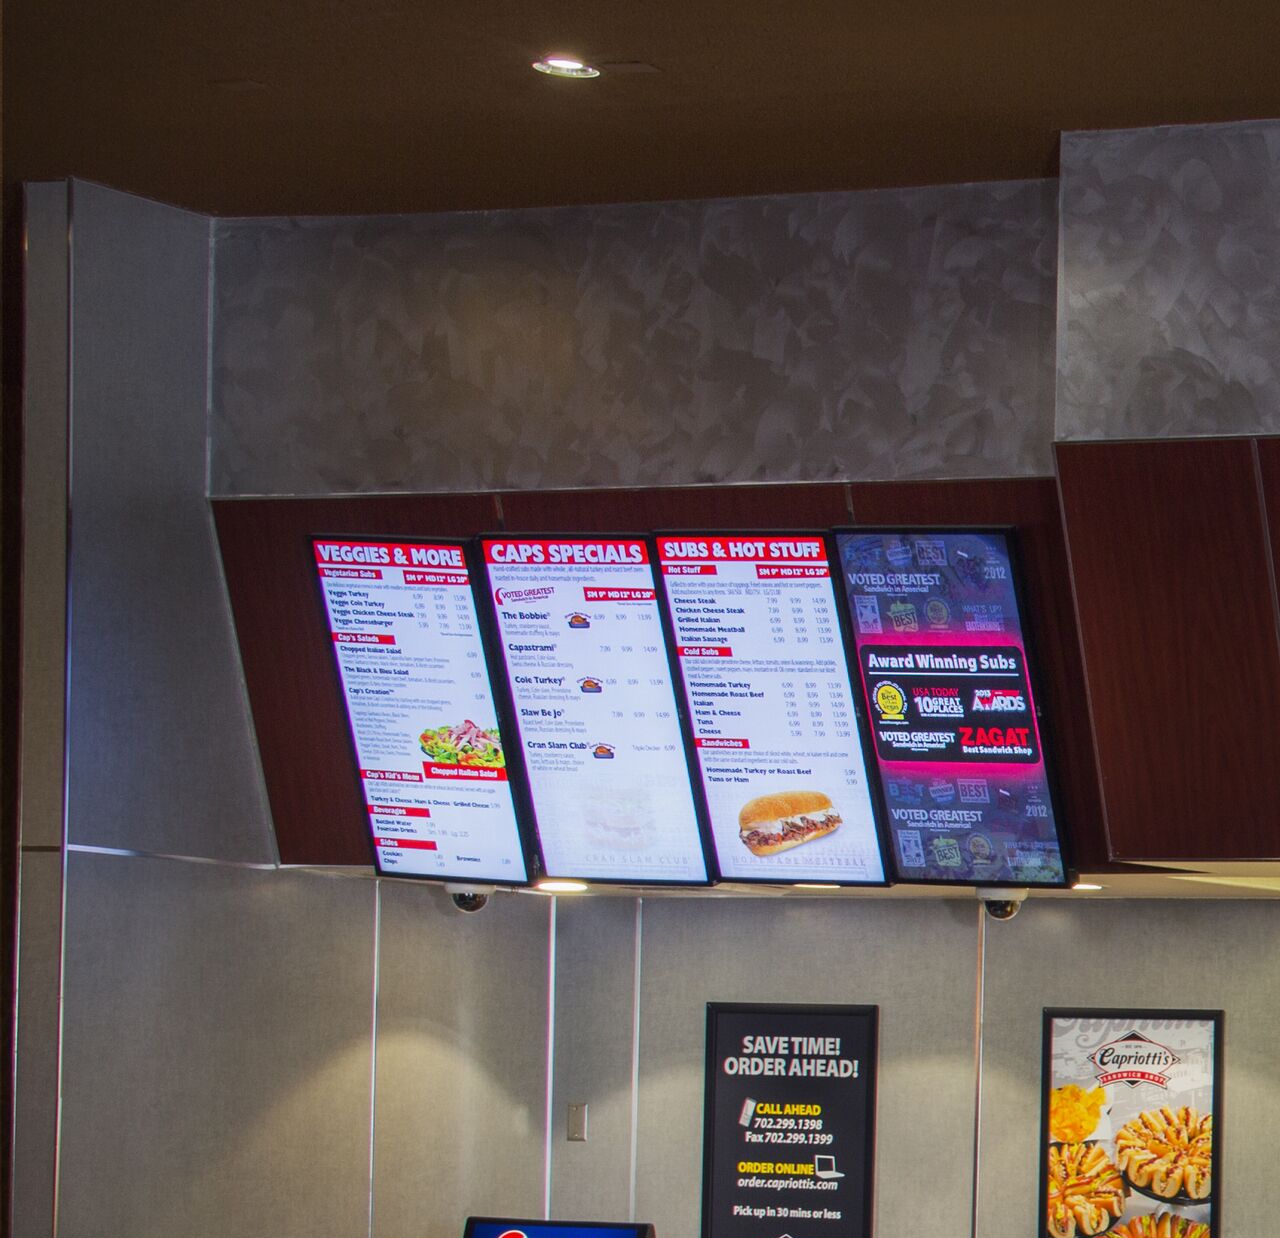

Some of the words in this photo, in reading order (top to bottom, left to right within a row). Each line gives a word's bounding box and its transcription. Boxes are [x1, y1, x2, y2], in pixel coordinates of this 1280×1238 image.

[490, 544, 545, 564] CAPS
[548, 544, 643, 564] SPECIALS
[663, 541, 709, 559] SUBS
[712, 542, 727, 558] &
[728, 542, 766, 558] HOT
[769, 541, 821, 559] STUFF
[316, 544, 391, 565] VEGGIES
[394, 548, 409, 566] &
[411, 548, 464, 567] MORE
[360, 570, 377, 579] Subs
[667, 566, 682, 575] Hot
[682, 566, 701, 575] Stuff
[848, 573, 886, 586] VOTED
[886, 573, 941, 586] GREATEST
[348, 590, 370, 600] Turkey
[501, 589, 524, 600] VOTED
[524, 586, 555, 597] GREATEST
[364, 601, 385, 610] Turkey
[697, 597, 717, 605] Steak
[352, 609, 376, 617] Chicken
[501, 611, 518, 620] The
[702, 607, 726, 615] Cheese
[726, 607, 746, 615] Steak
[677, 616, 699, 624] Grilled
[679, 626, 717, 634] Homemade
[717, 626, 746, 634] Meatball
[357, 635, 380, 644] Salads
[702, 635, 729, 645] Sausage
[868, 653, 914, 670] Award
[914, 653, 978, 673] Winning
[979, 654, 1017, 671] Subs
[514, 676, 533, 684] Cole
[690, 681, 727, 689] Homemade
[727, 682, 752, 691] Turkey
[729, 691, 749, 699] Roast
[749, 691, 765, 699] Beef
[912, 687, 931, 697] USA
[931, 687, 960, 698] TODAY
[914, 696, 933, 714] 10
[932, 697, 961, 706] GREAT
[932, 705, 964, 714] PLACES
[520, 708, 540, 717] Slaw
[541, 708, 552, 717] Be
[695, 709, 711, 717] Ham
[718, 710, 742, 718] Cheese
[696, 718, 714, 726] Tuna
[698, 728, 722, 736] Cheese
[958, 726, 1030, 747] ZAGAT
[879, 731, 911, 743] VOTED
[911, 731, 956, 744] GREATEST
[527, 741, 547, 750] Cran
[547, 741, 568, 750] Slam
[701, 739, 744, 749] Sandwiches
[962, 745, 979, 755] Best
[979, 745, 1014, 755] Sandwich
[1014, 746, 1033, 757] Shop
[706, 767, 744, 775] Homemade
[744, 768, 768, 776] Turkey
[776, 768, 796, 776] Roast
[796, 768, 813, 776] Beef
[891, 808, 929, 821] VOTED
[929, 809, 983, 823] GREATEST
[742, 1035, 789, 1055] SAVE
[790, 1036, 841, 1056] TIME!
[1098, 1047, 1170, 1070] Capriotti's
[723, 1056, 787, 1076] ORDER
[788, 1058, 859, 1079] AHEAD!
[755, 1103, 783, 1115] CALL
[783, 1103, 822, 1116] AHEAD
[753, 1117, 824, 1130] 702.299.1398
[744, 1131, 764, 1143] Fax
[764, 1131, 834, 1146] 702.299.1399
[737, 1161, 775, 1174] ORDER
[775, 1162, 816, 1176] ONLINE
[737, 1175, 839, 1191] order.capriottis.com
[732, 1205, 753, 1217] Pick
[753, 1208, 766, 1219] up
[766, 1206, 776, 1217] in
[776, 1207, 789, 1218] 30
[789, 1207, 812, 1218] mins
[812, 1210, 824, 1219] or
[823, 1208, 842, 1220] less
